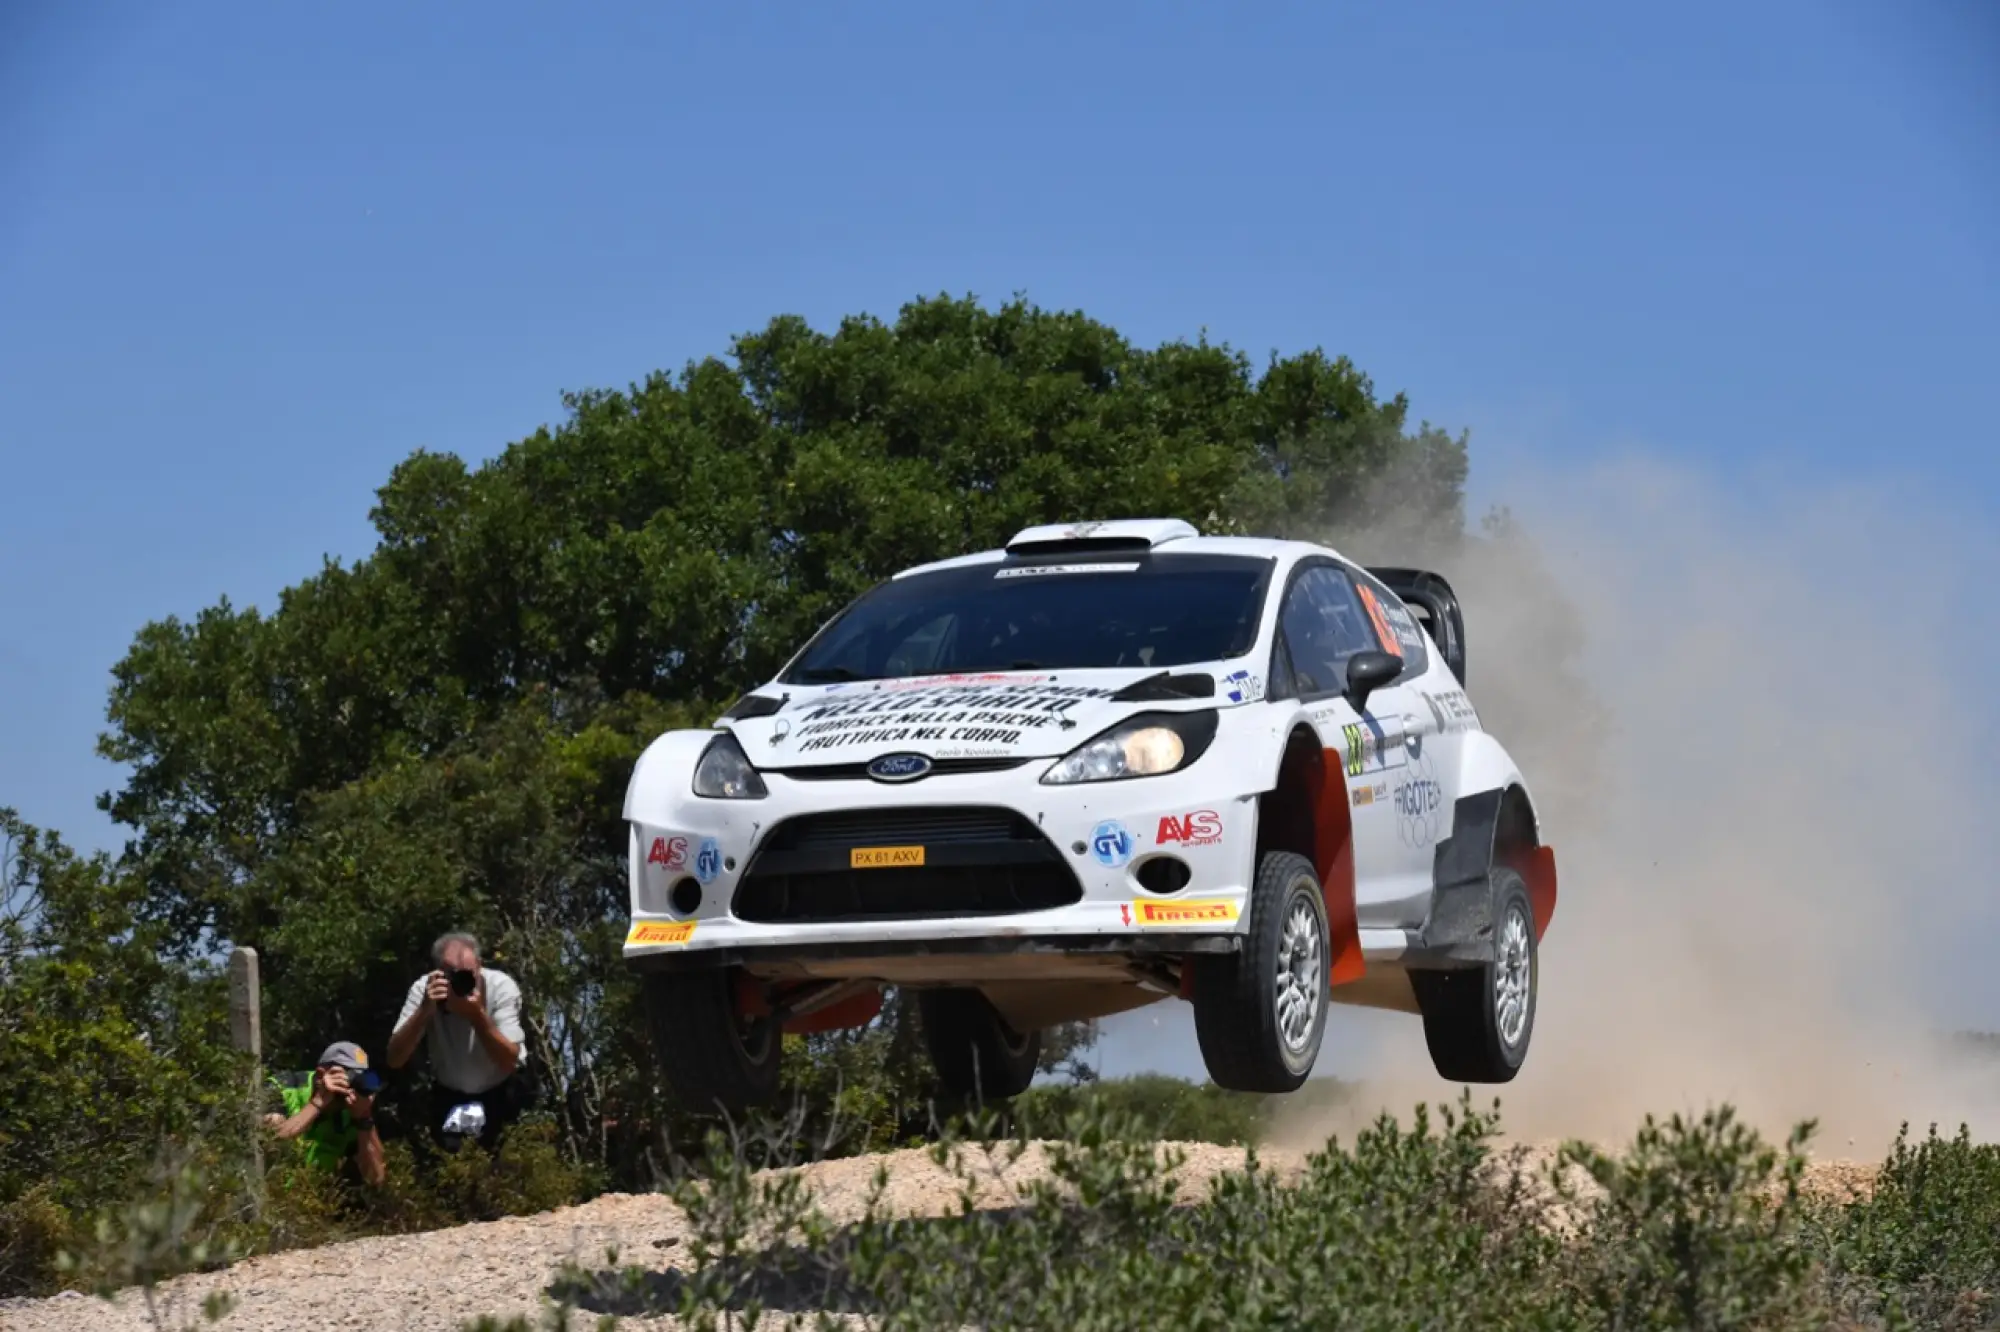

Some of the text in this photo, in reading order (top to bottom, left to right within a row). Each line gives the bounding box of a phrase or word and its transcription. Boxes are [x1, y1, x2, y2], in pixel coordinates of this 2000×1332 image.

[800, 697, 926, 722] NELLO
[796, 713, 898, 738] FIORISCE
[895, 711, 968, 724] NELLA
[798, 727, 1023, 753] FRUTTIFICA NEL CORPO.
[1156, 810, 1223, 846] AVS
[647, 836, 689, 865] AVS
[855, 849, 920, 864] PX 61 AXV
[1144, 904, 1229, 921] PIRELLI
[634, 923, 692, 941] PIRELLI
